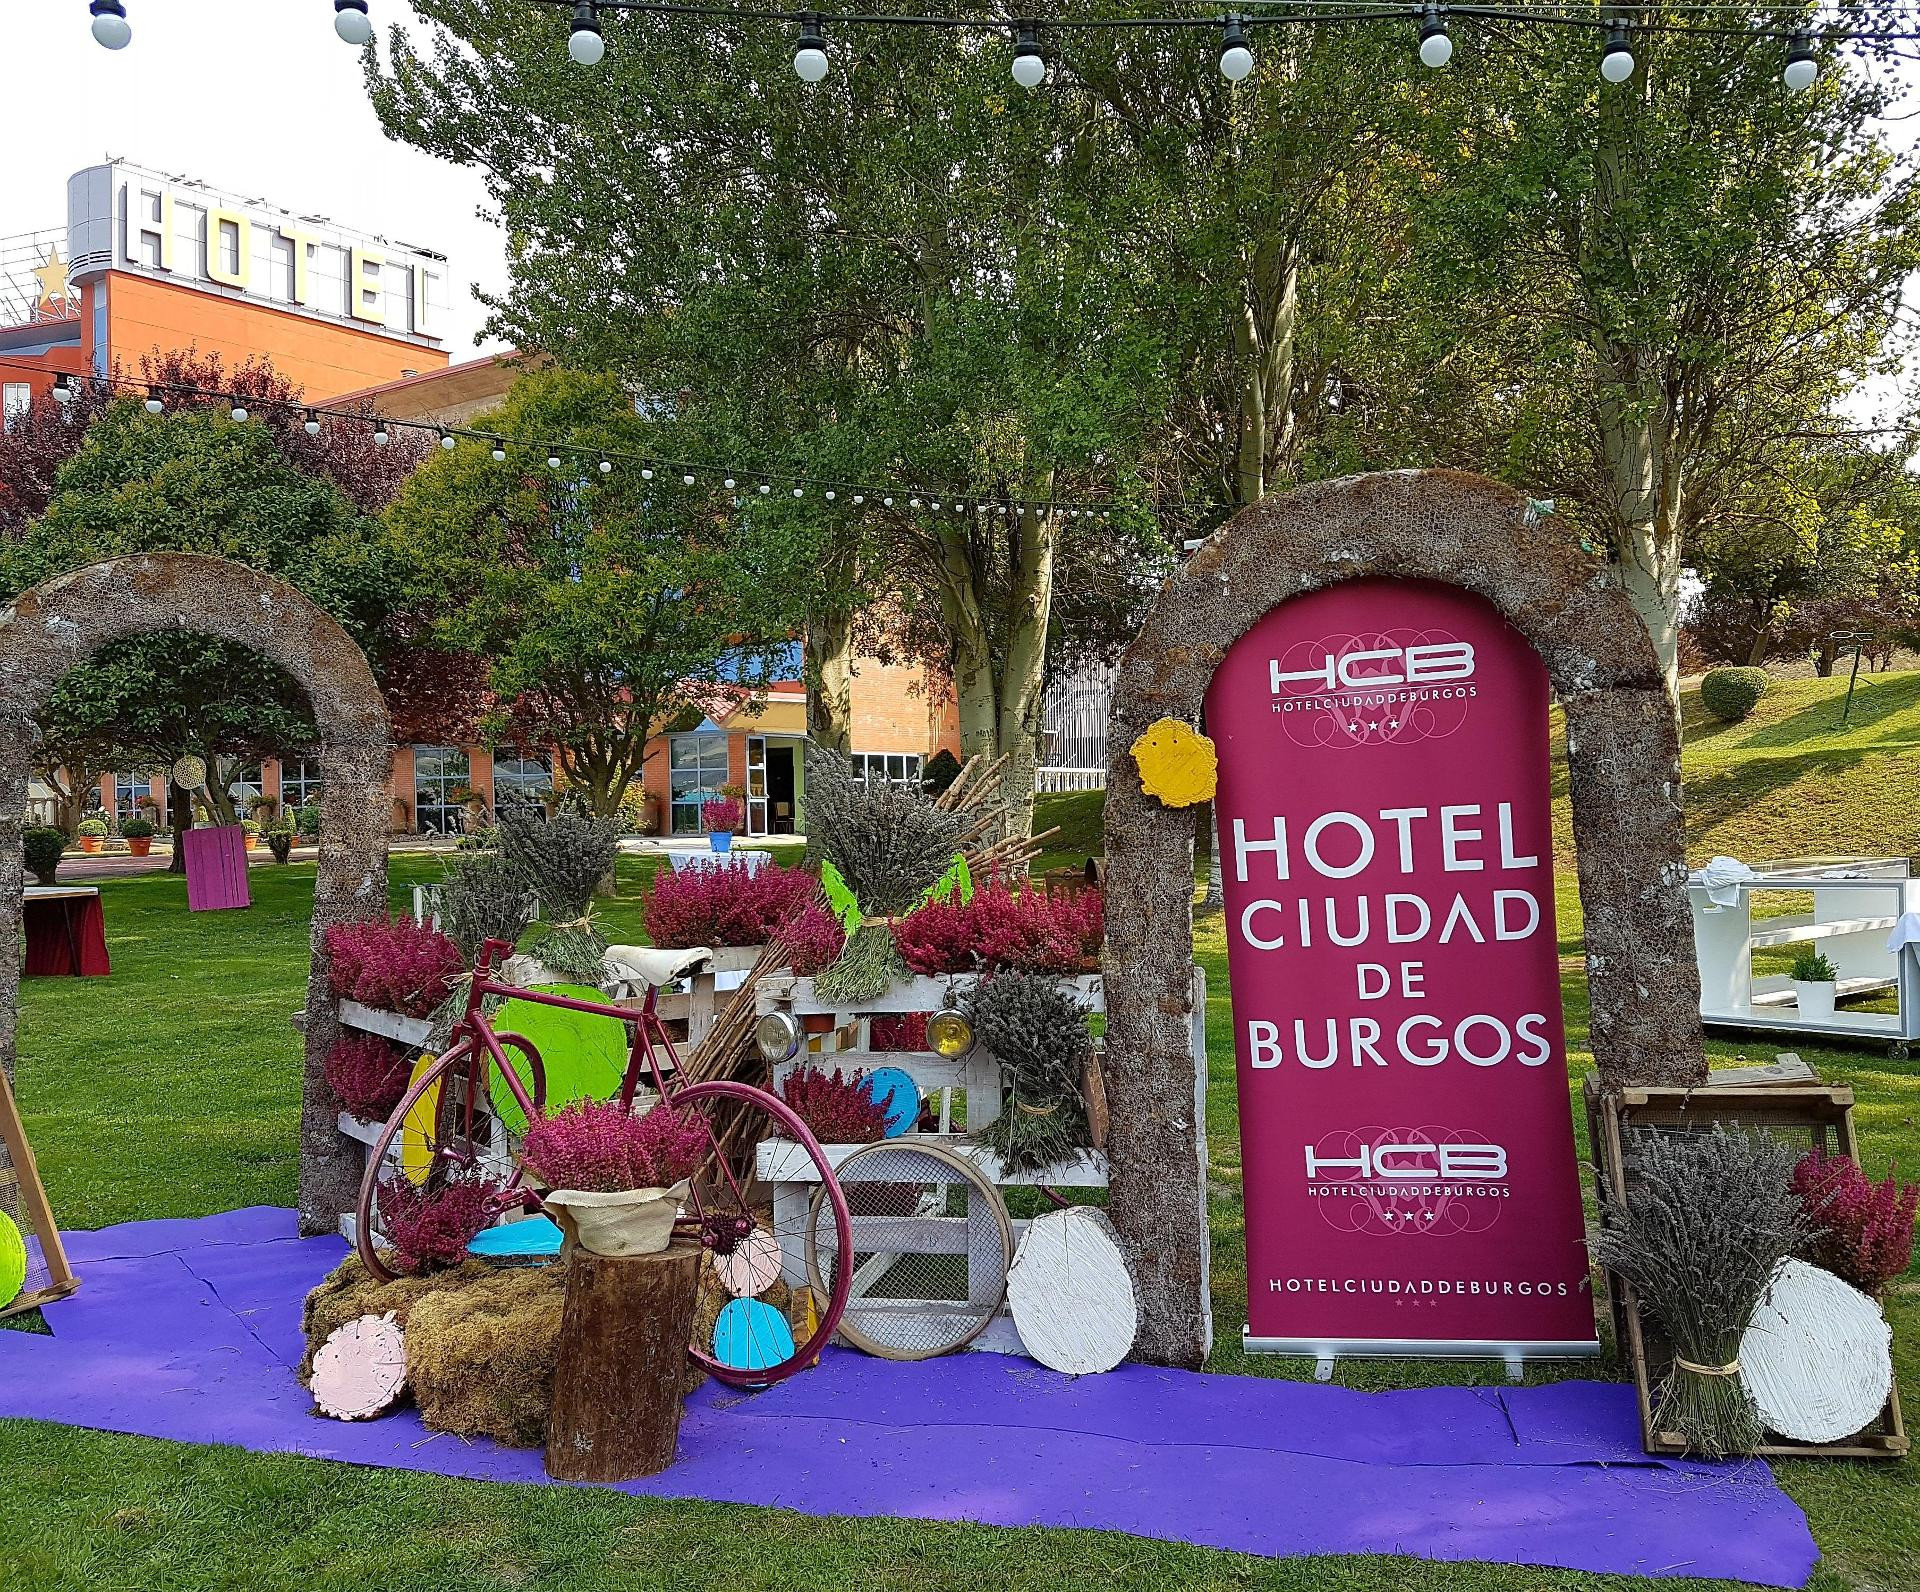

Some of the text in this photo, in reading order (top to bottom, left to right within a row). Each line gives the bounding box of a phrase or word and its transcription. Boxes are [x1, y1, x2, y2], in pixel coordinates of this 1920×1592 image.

[122, 179, 442, 340] HOTEL
[1269, 642, 1475, 694] HCB
[1271, 686, 1477, 713] HOTELCIUDADDEBURGOS
[1233, 802, 1538, 882] HOTEL
[1241, 889, 1540, 950] CIUDAD
[1356, 961, 1426, 1000] DE
[1248, 1013, 1551, 1069] BURGOS
[1304, 1143, 1507, 1179] HCB
[1308, 1186, 1510, 1198] HOTELCIUDADDEBURGOS
[1269, 1278, 1567, 1296] HOTELCIUDADDEBURGOS
